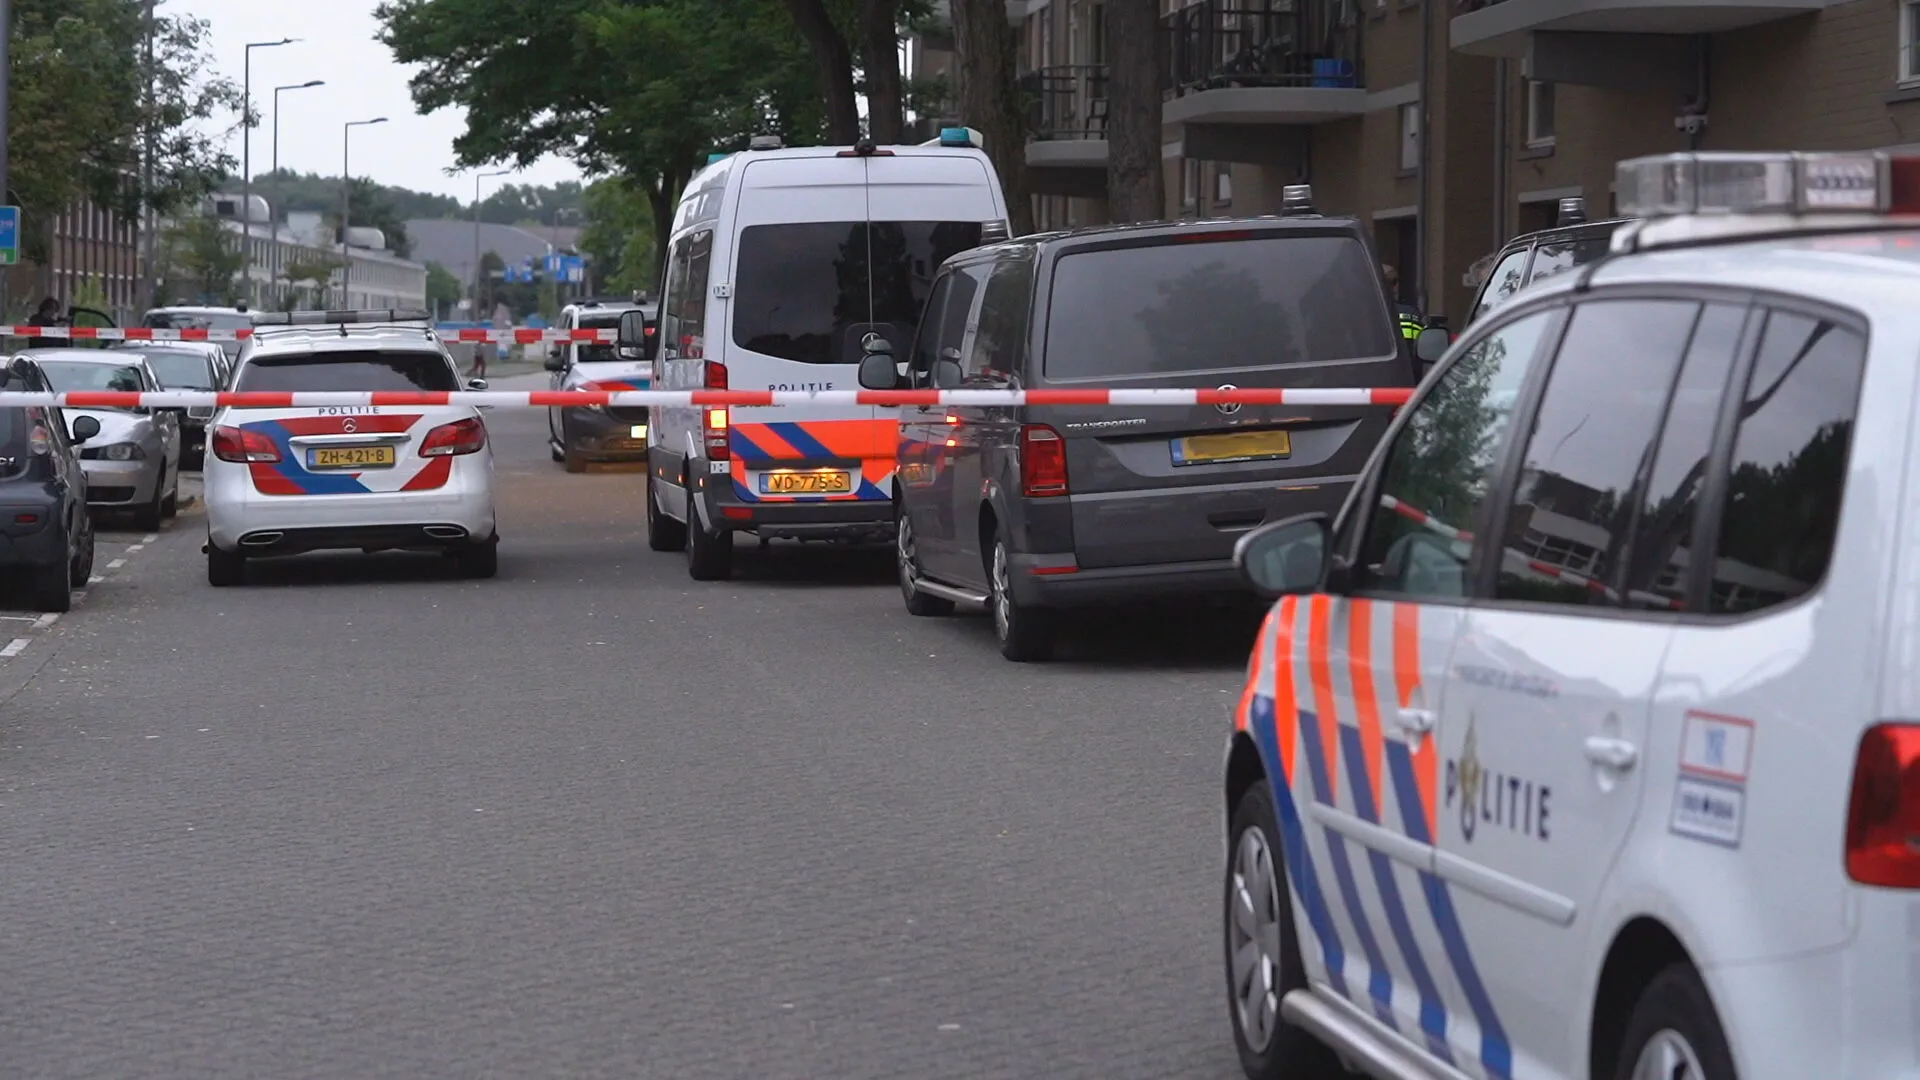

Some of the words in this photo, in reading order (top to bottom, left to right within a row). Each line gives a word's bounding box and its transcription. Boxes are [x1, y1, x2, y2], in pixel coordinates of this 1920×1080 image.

[318, 406, 380, 415] POLITIE
[319, 449, 385, 464] ZH-421-B
[1446, 757, 1552, 843] POLITIE
